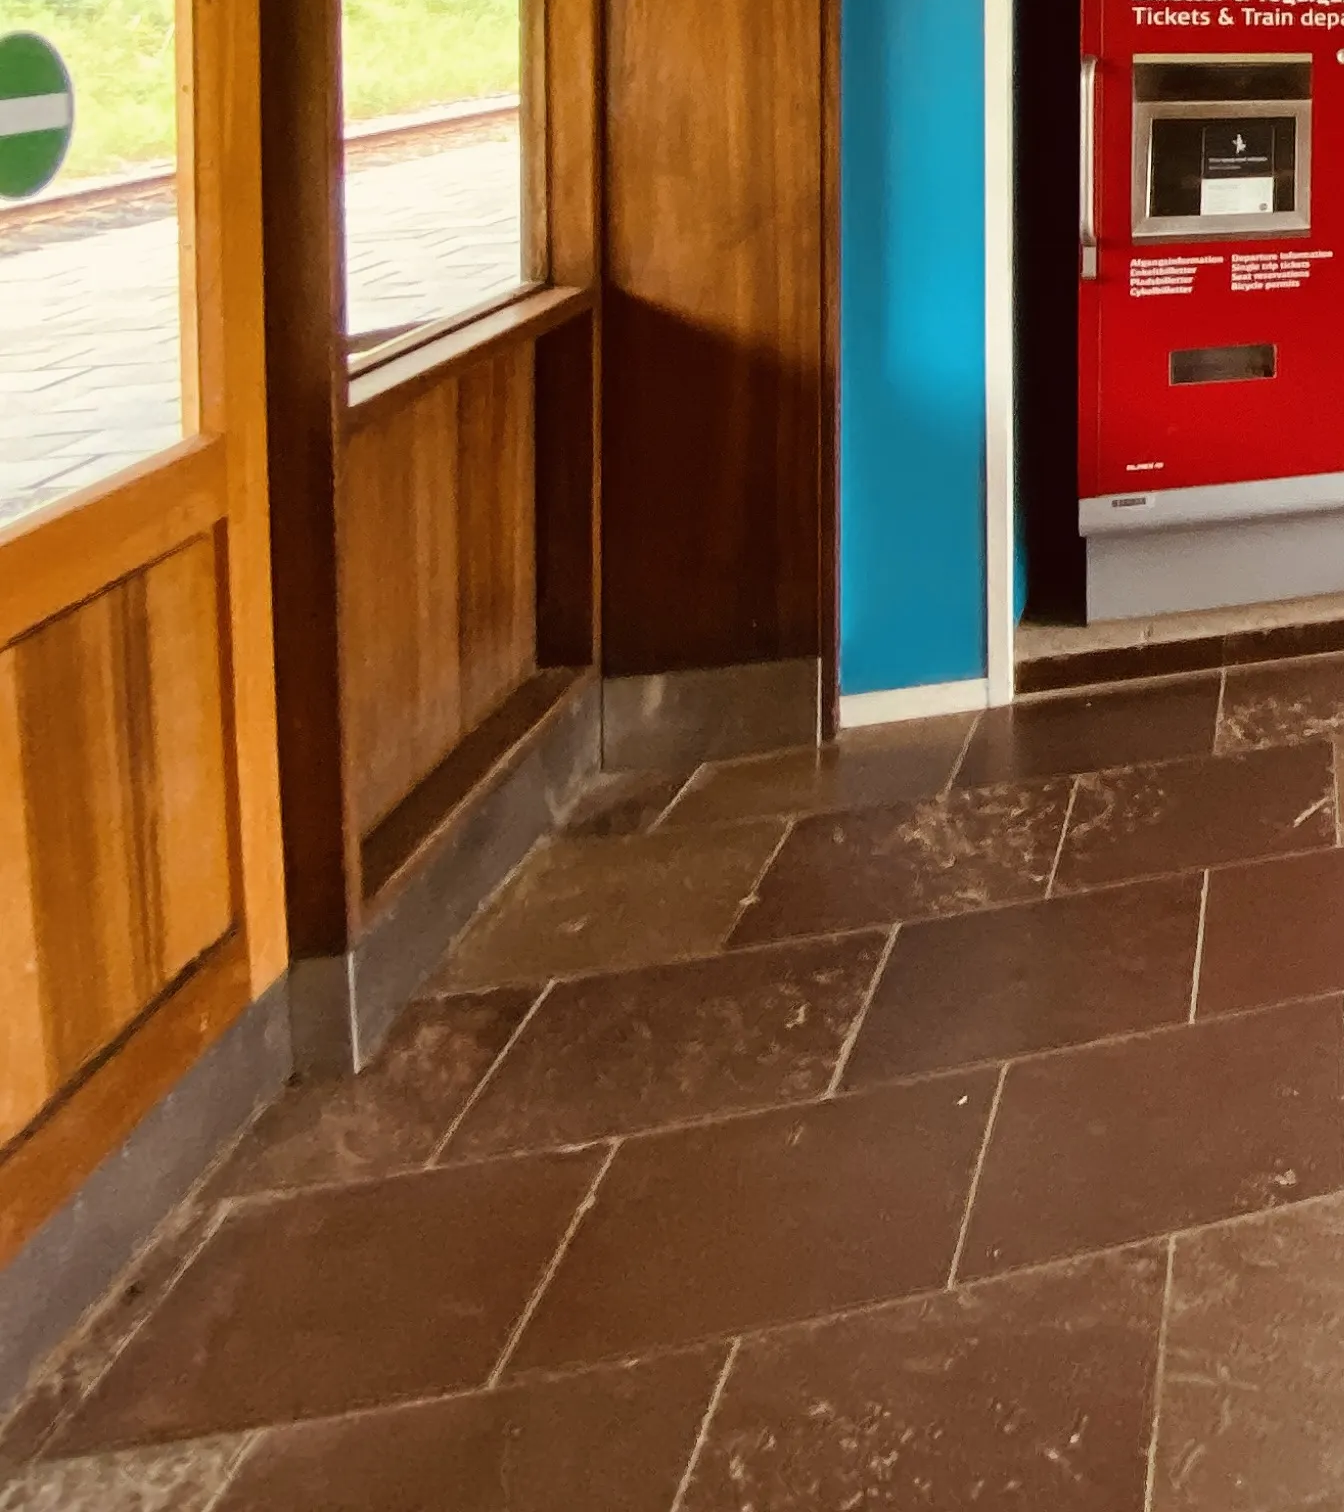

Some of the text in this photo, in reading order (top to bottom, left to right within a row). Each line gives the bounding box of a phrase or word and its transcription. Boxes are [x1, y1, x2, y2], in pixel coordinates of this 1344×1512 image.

[1132, 7, 1211, 26] Tickets
[1217, 8, 1235, 26] &
[1241, 8, 1294, 26] Train
